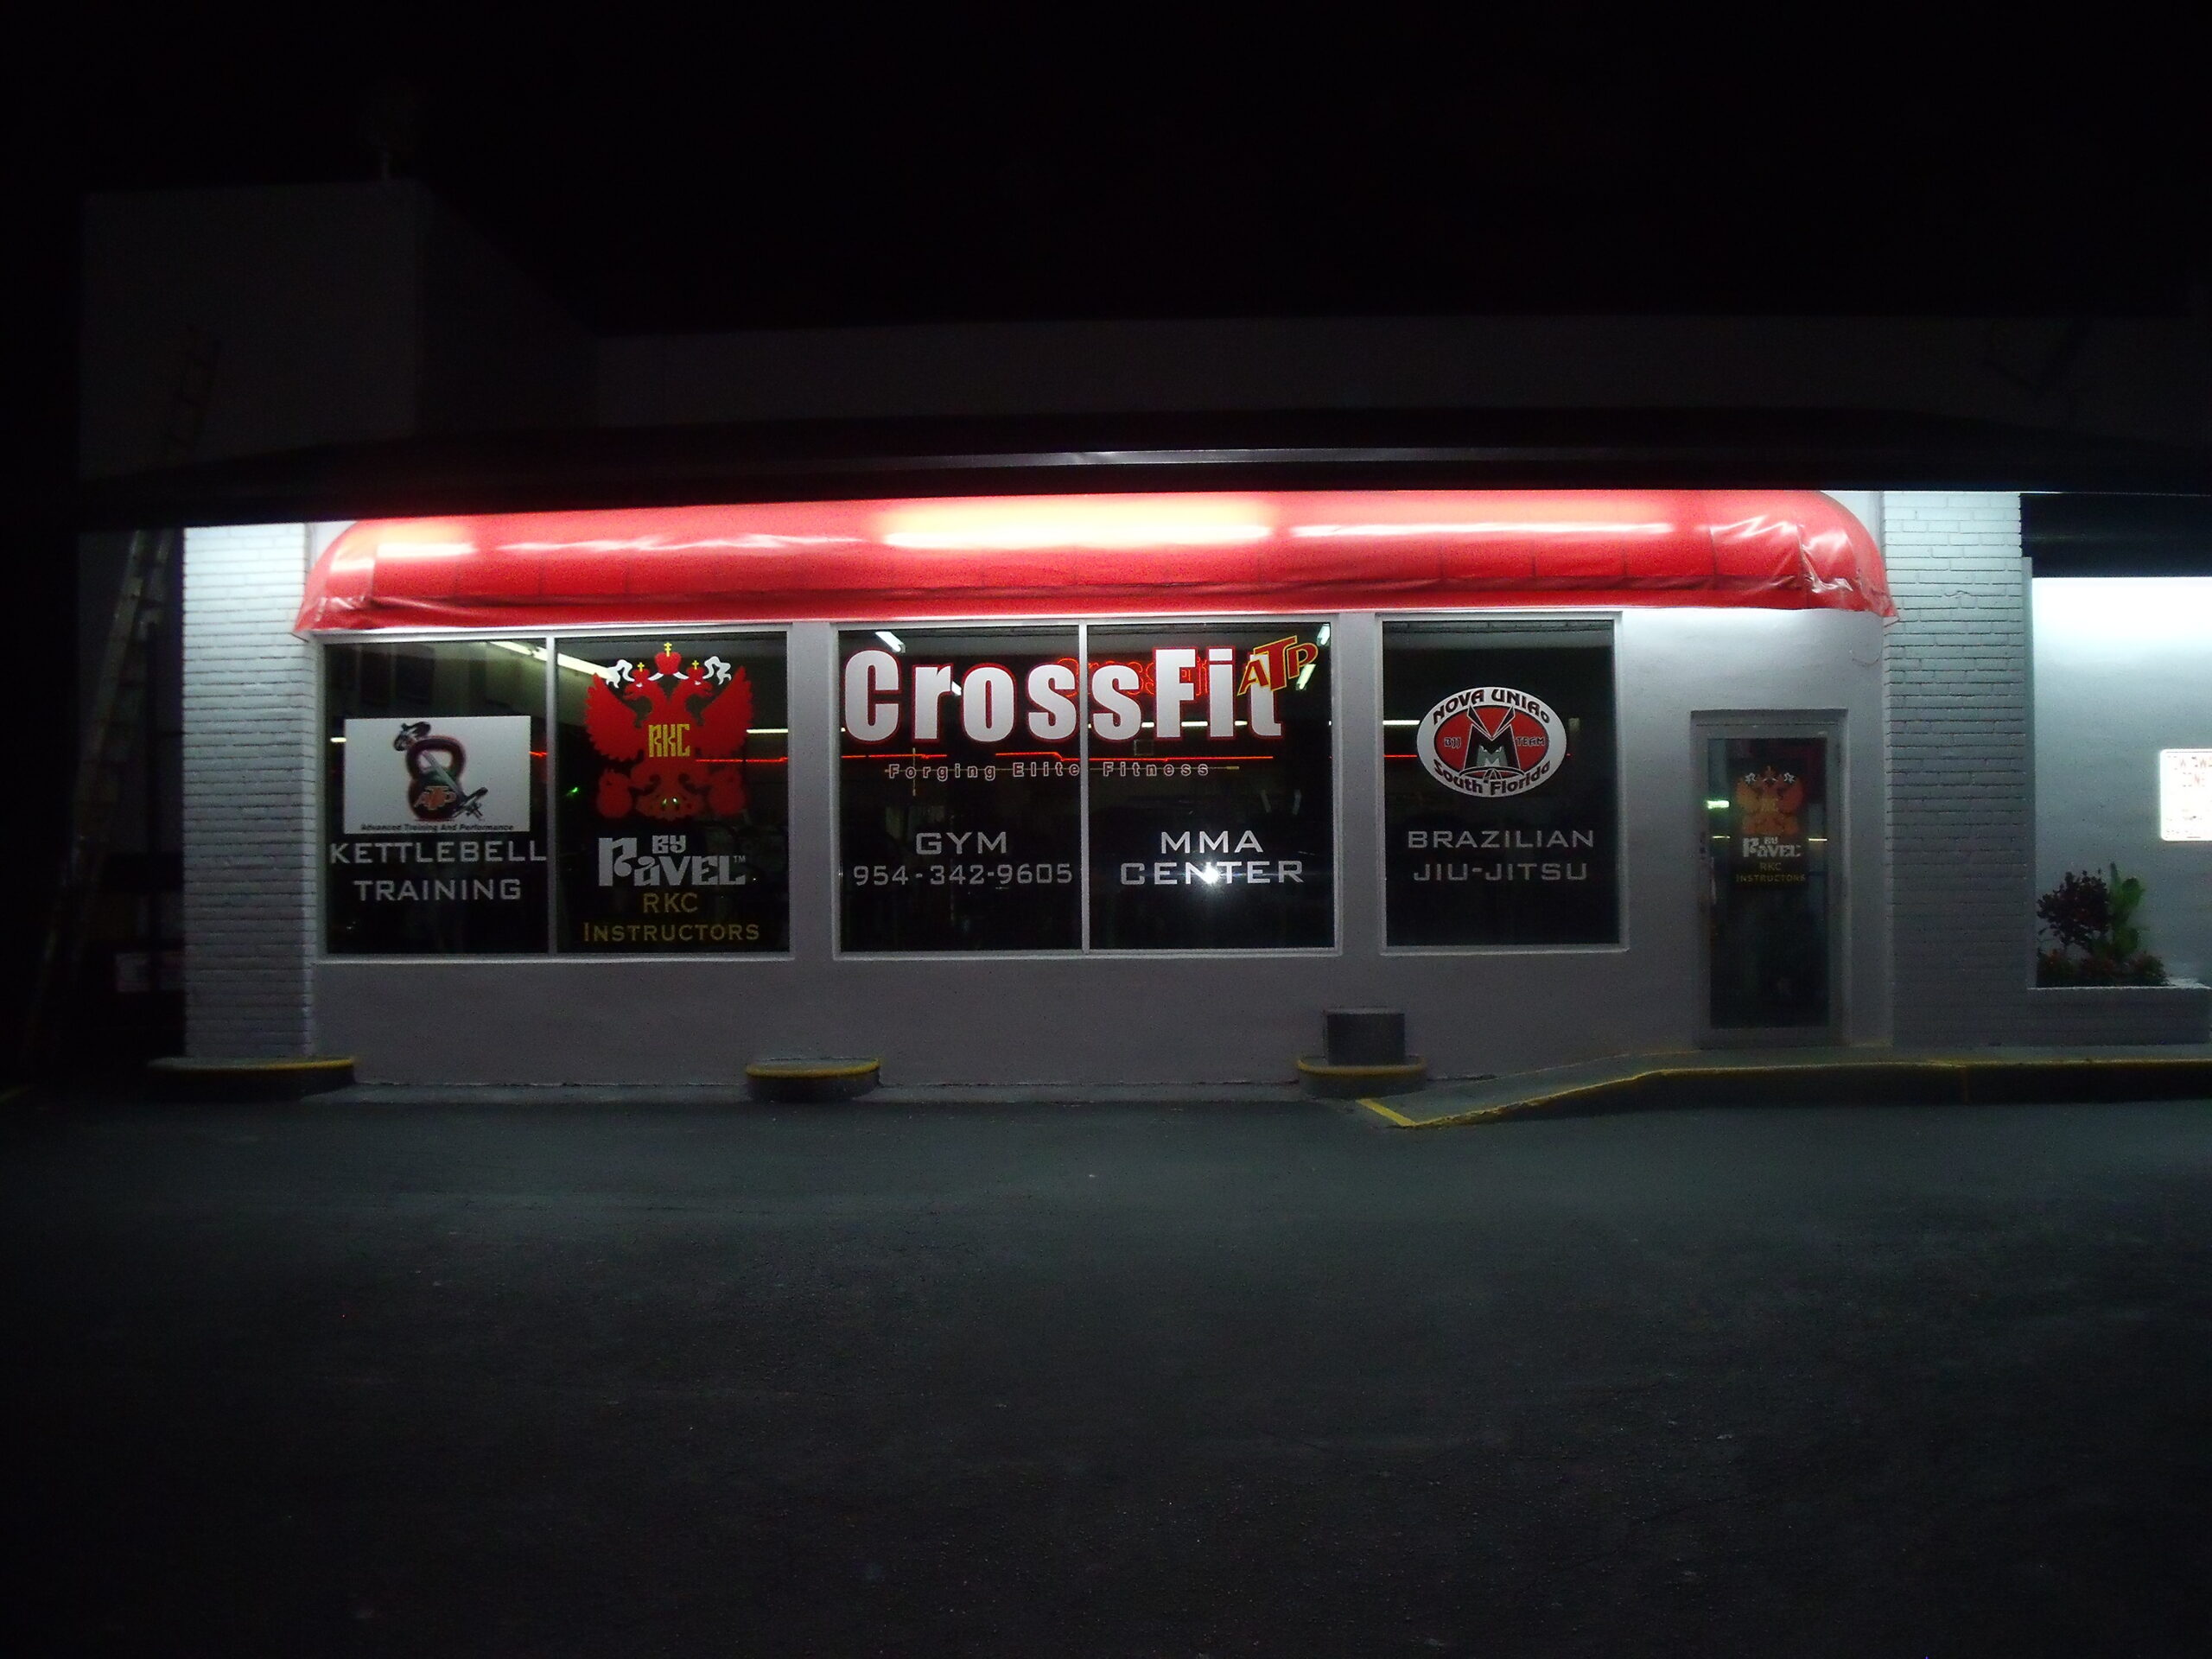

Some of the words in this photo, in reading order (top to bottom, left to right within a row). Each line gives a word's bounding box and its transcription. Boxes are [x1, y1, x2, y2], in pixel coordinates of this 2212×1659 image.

[1236, 635, 1319, 696] ATP
[843, 647, 1282, 743] CrossFit
[1433, 690, 1484, 725] NOVA
[1516, 736, 1546, 747] TEAM
[887, 763, 996, 781] Forging
[1013, 761, 1080, 778] Elite
[1103, 761, 1209, 777] Fitness
[1433, 759, 1483, 794] South
[1490, 760, 1551, 796] Florida
[916, 831, 1007, 855] GYM
[1160, 830, 1264, 855] MMA
[1408, 830, 1594, 849] BRAZILIAN
[330, 840, 548, 864] KETTLEBELL
[1120, 860, 1305, 886] CENTER
[1413, 863, 1588, 881] JIU-JITSU
[353, 879, 522, 901] TRAINING
[642, 893, 699, 913] RKC
